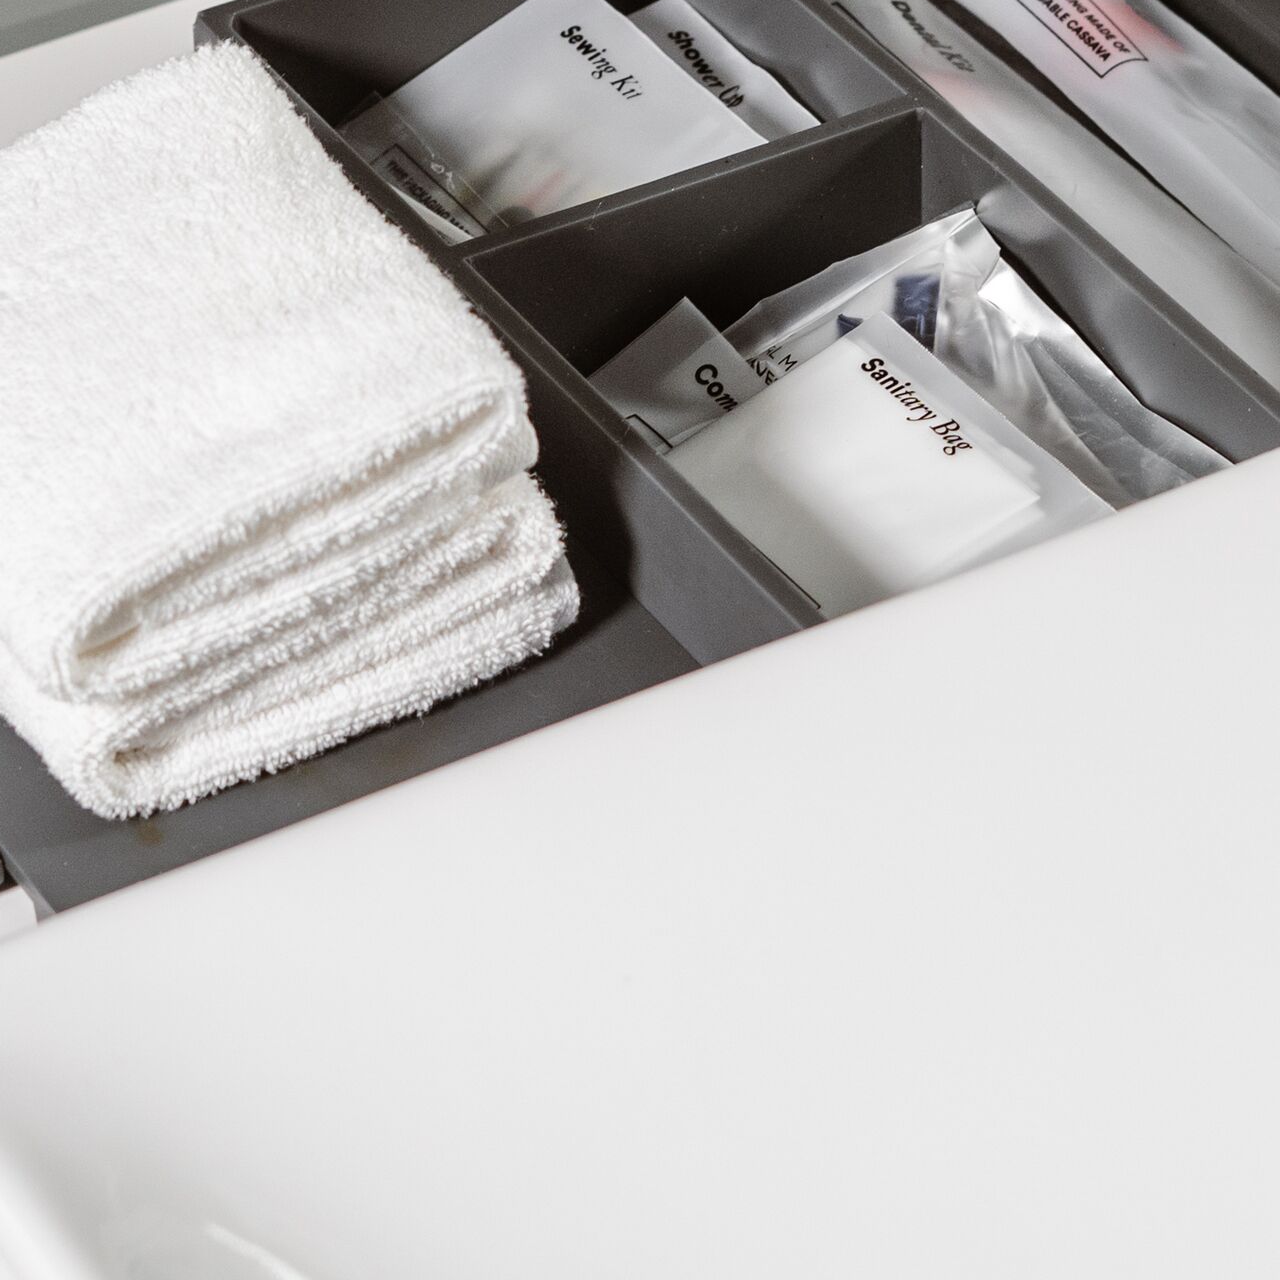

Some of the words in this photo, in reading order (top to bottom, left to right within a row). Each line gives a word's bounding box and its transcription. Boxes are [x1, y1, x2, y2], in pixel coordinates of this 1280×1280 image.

[560, 25, 618, 80] Sewing
[1066, 19, 1111, 63] CASSAVA
[1085, 12, 1116, 41] MADE
[1113, 38, 1131, 54] OF
[668, 30, 725, 89] Shower
[694, 363, 739, 413] Com
[860, 358, 937, 422] Sanitary
[929, 418, 973, 456] Bag
